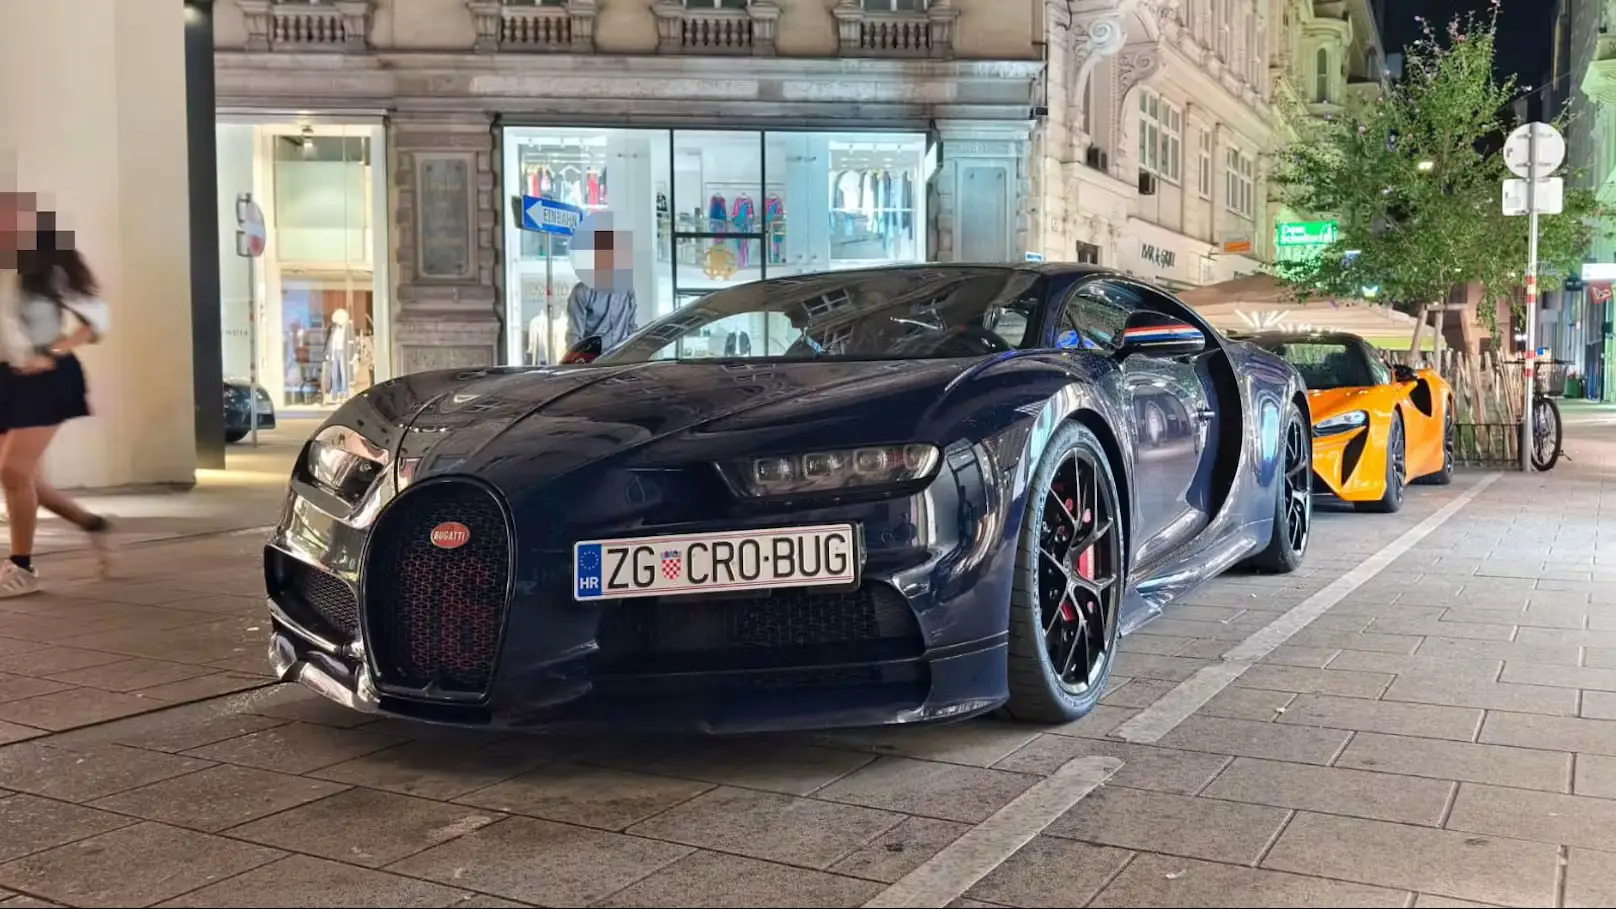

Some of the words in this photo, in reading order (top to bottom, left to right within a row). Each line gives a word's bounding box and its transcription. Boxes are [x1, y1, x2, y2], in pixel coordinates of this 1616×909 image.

[543, 208, 577, 227] EINBAHN
[433, 530, 466, 541] BUGATTI
[607, 546, 656, 589] ZG
[579, 577, 600, 590] HR
